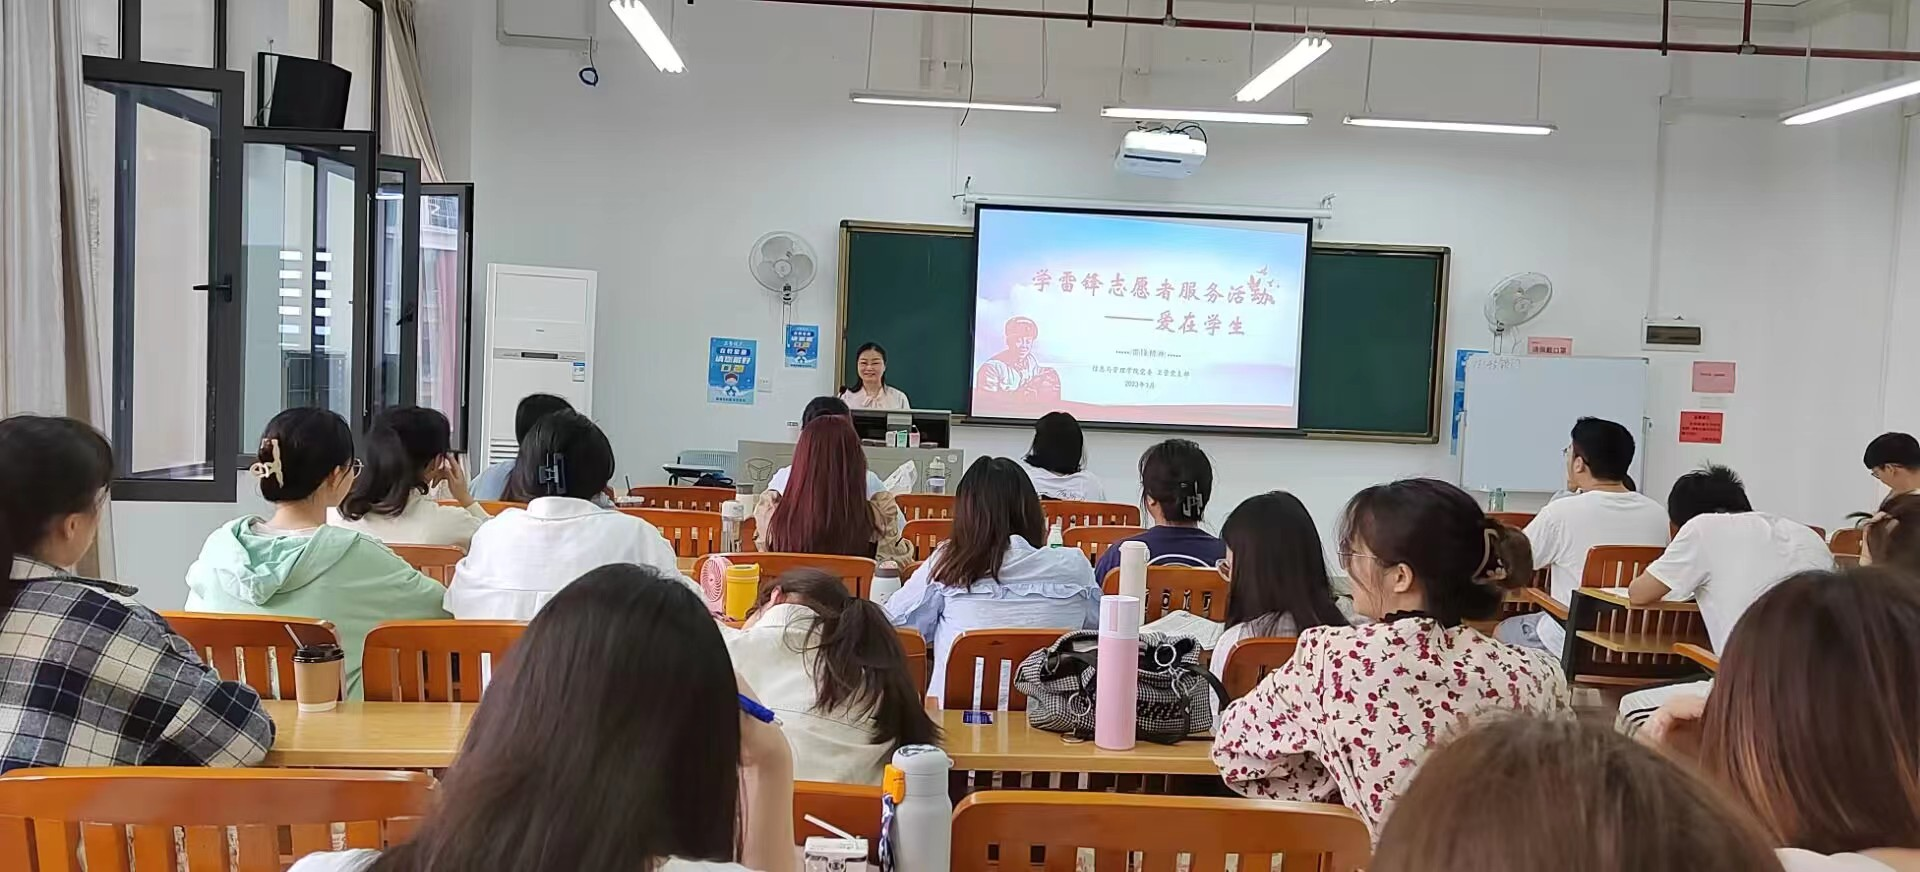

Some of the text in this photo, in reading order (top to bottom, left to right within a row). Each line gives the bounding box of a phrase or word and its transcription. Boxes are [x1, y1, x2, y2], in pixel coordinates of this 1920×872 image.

[1032, 268, 1276, 306] 学雷锋志愿者服务活动
